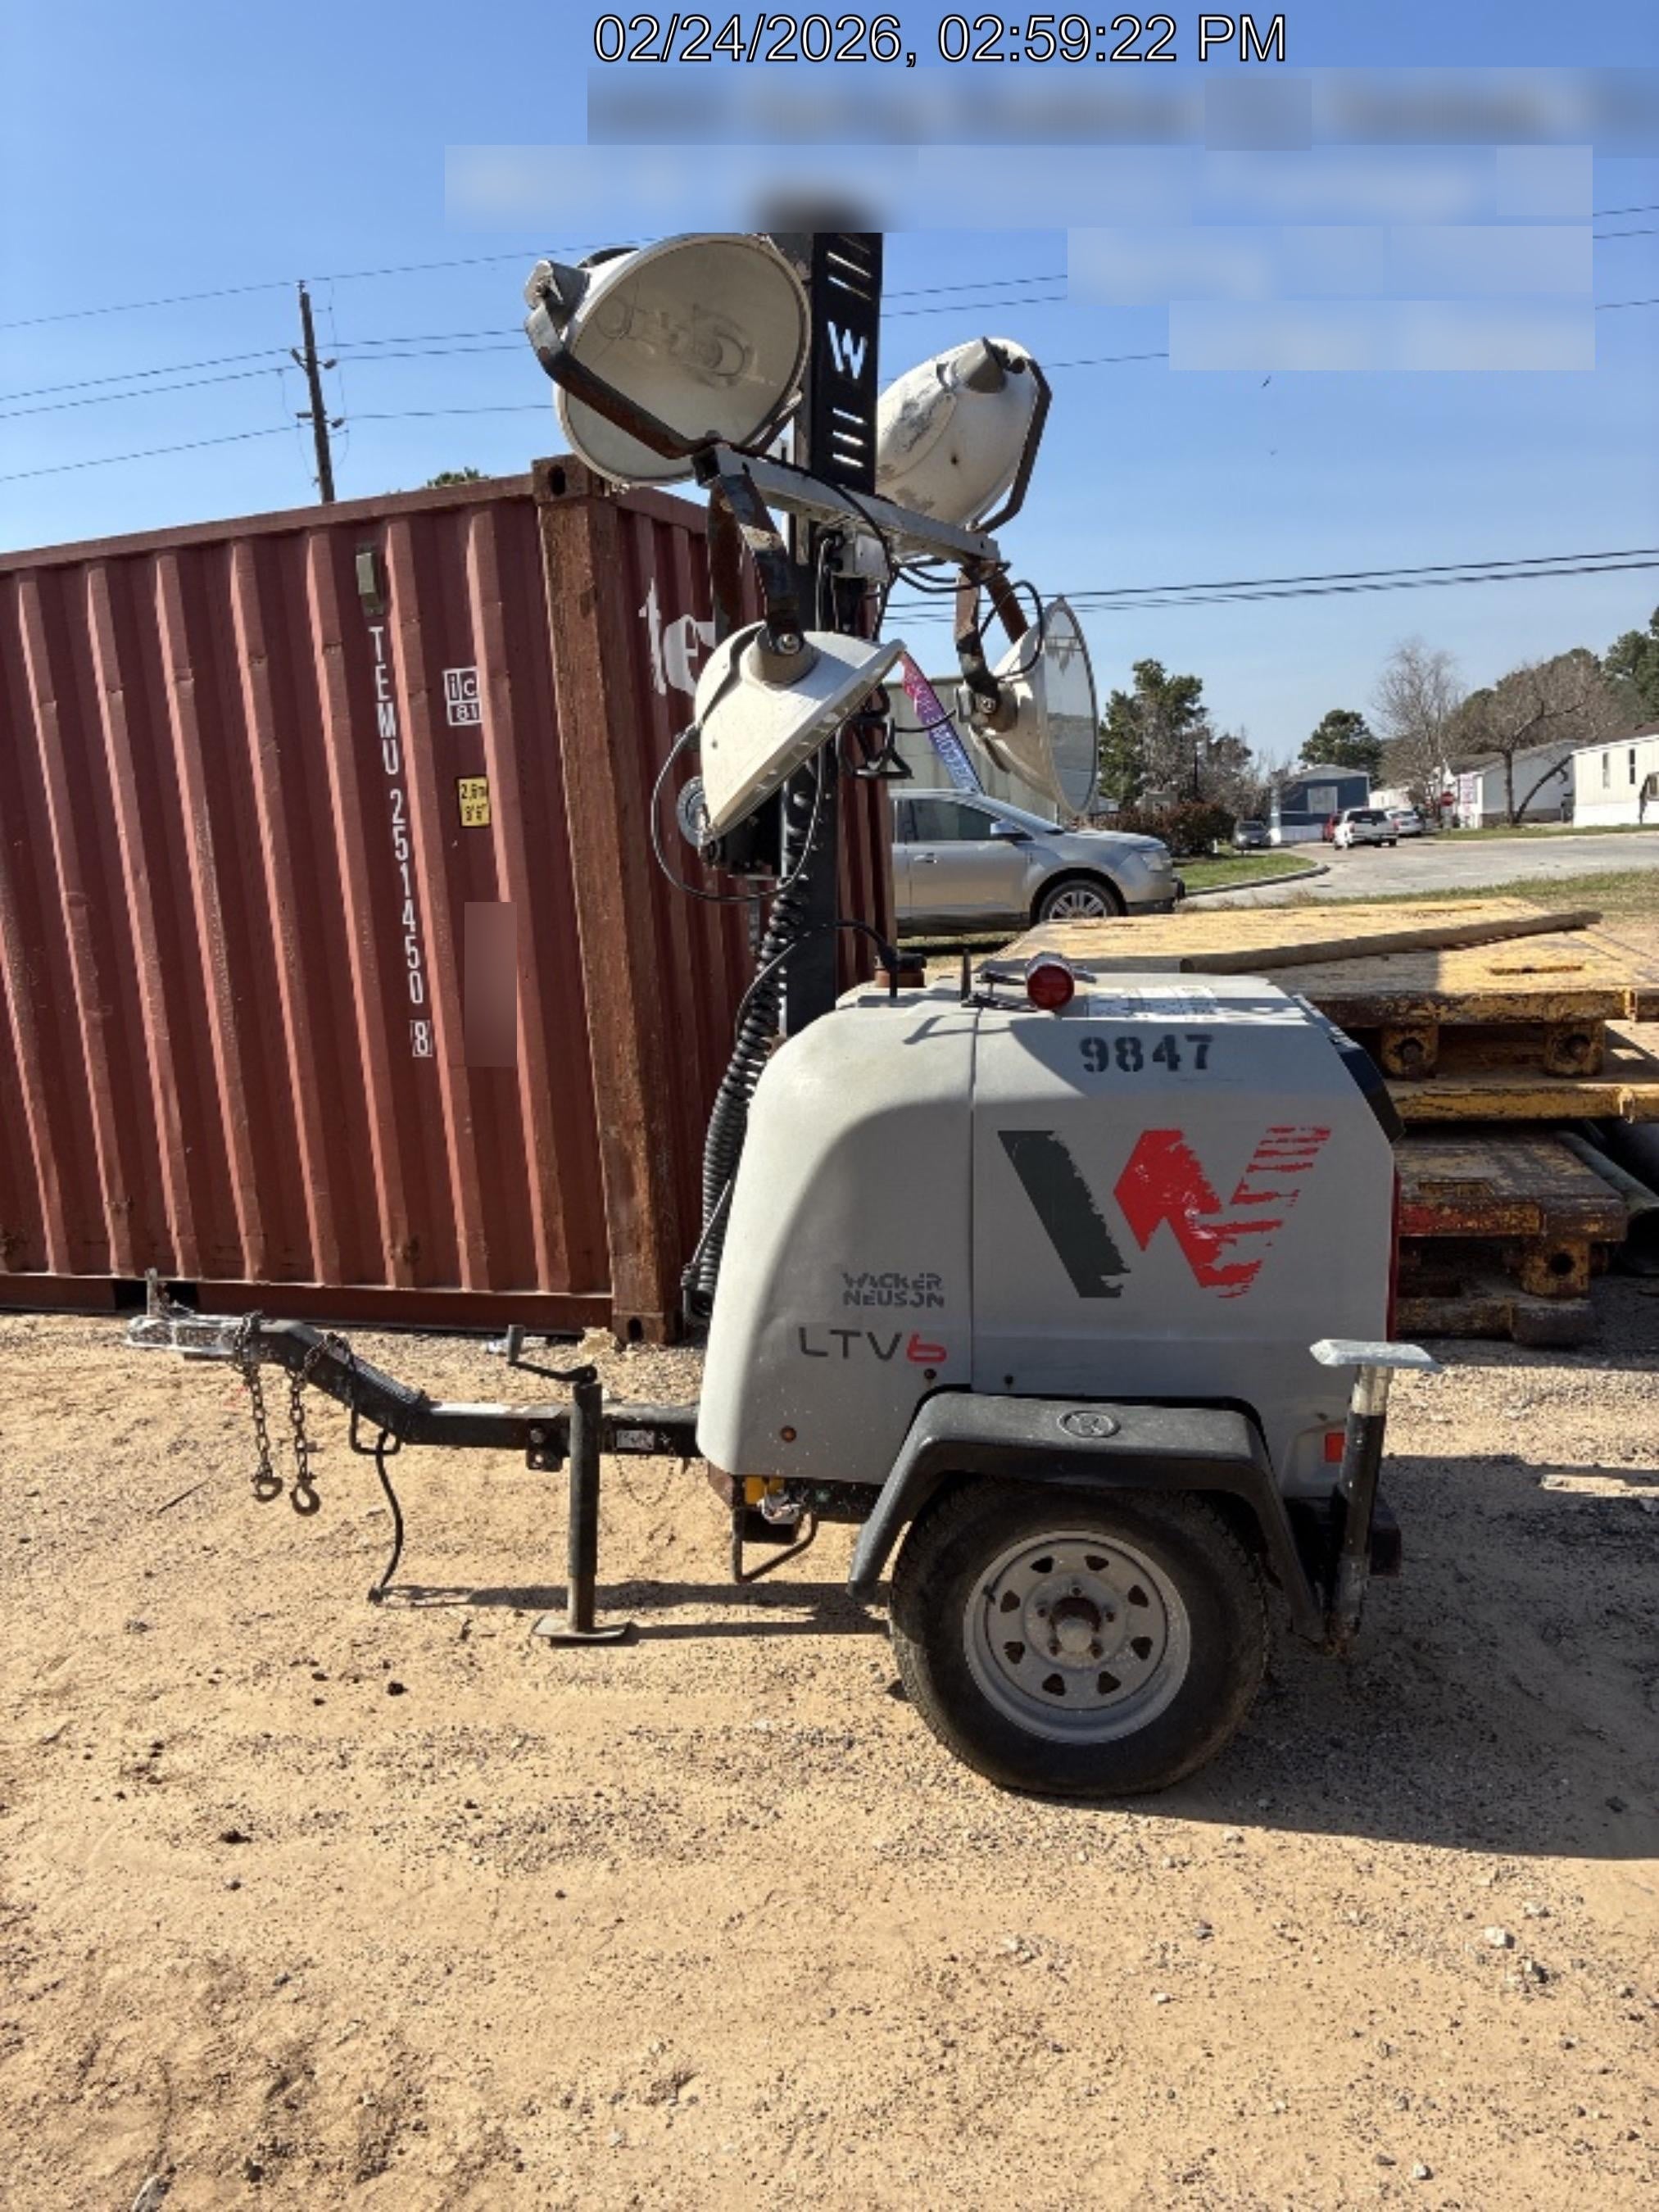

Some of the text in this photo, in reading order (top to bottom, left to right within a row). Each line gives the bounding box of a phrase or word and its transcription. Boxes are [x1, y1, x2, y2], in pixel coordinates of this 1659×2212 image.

[368, 625, 428, 1056] TEMU 251450 8
[1080, 1034, 1214, 1072] 9847
[798, 1326, 948, 1363] LTV6
